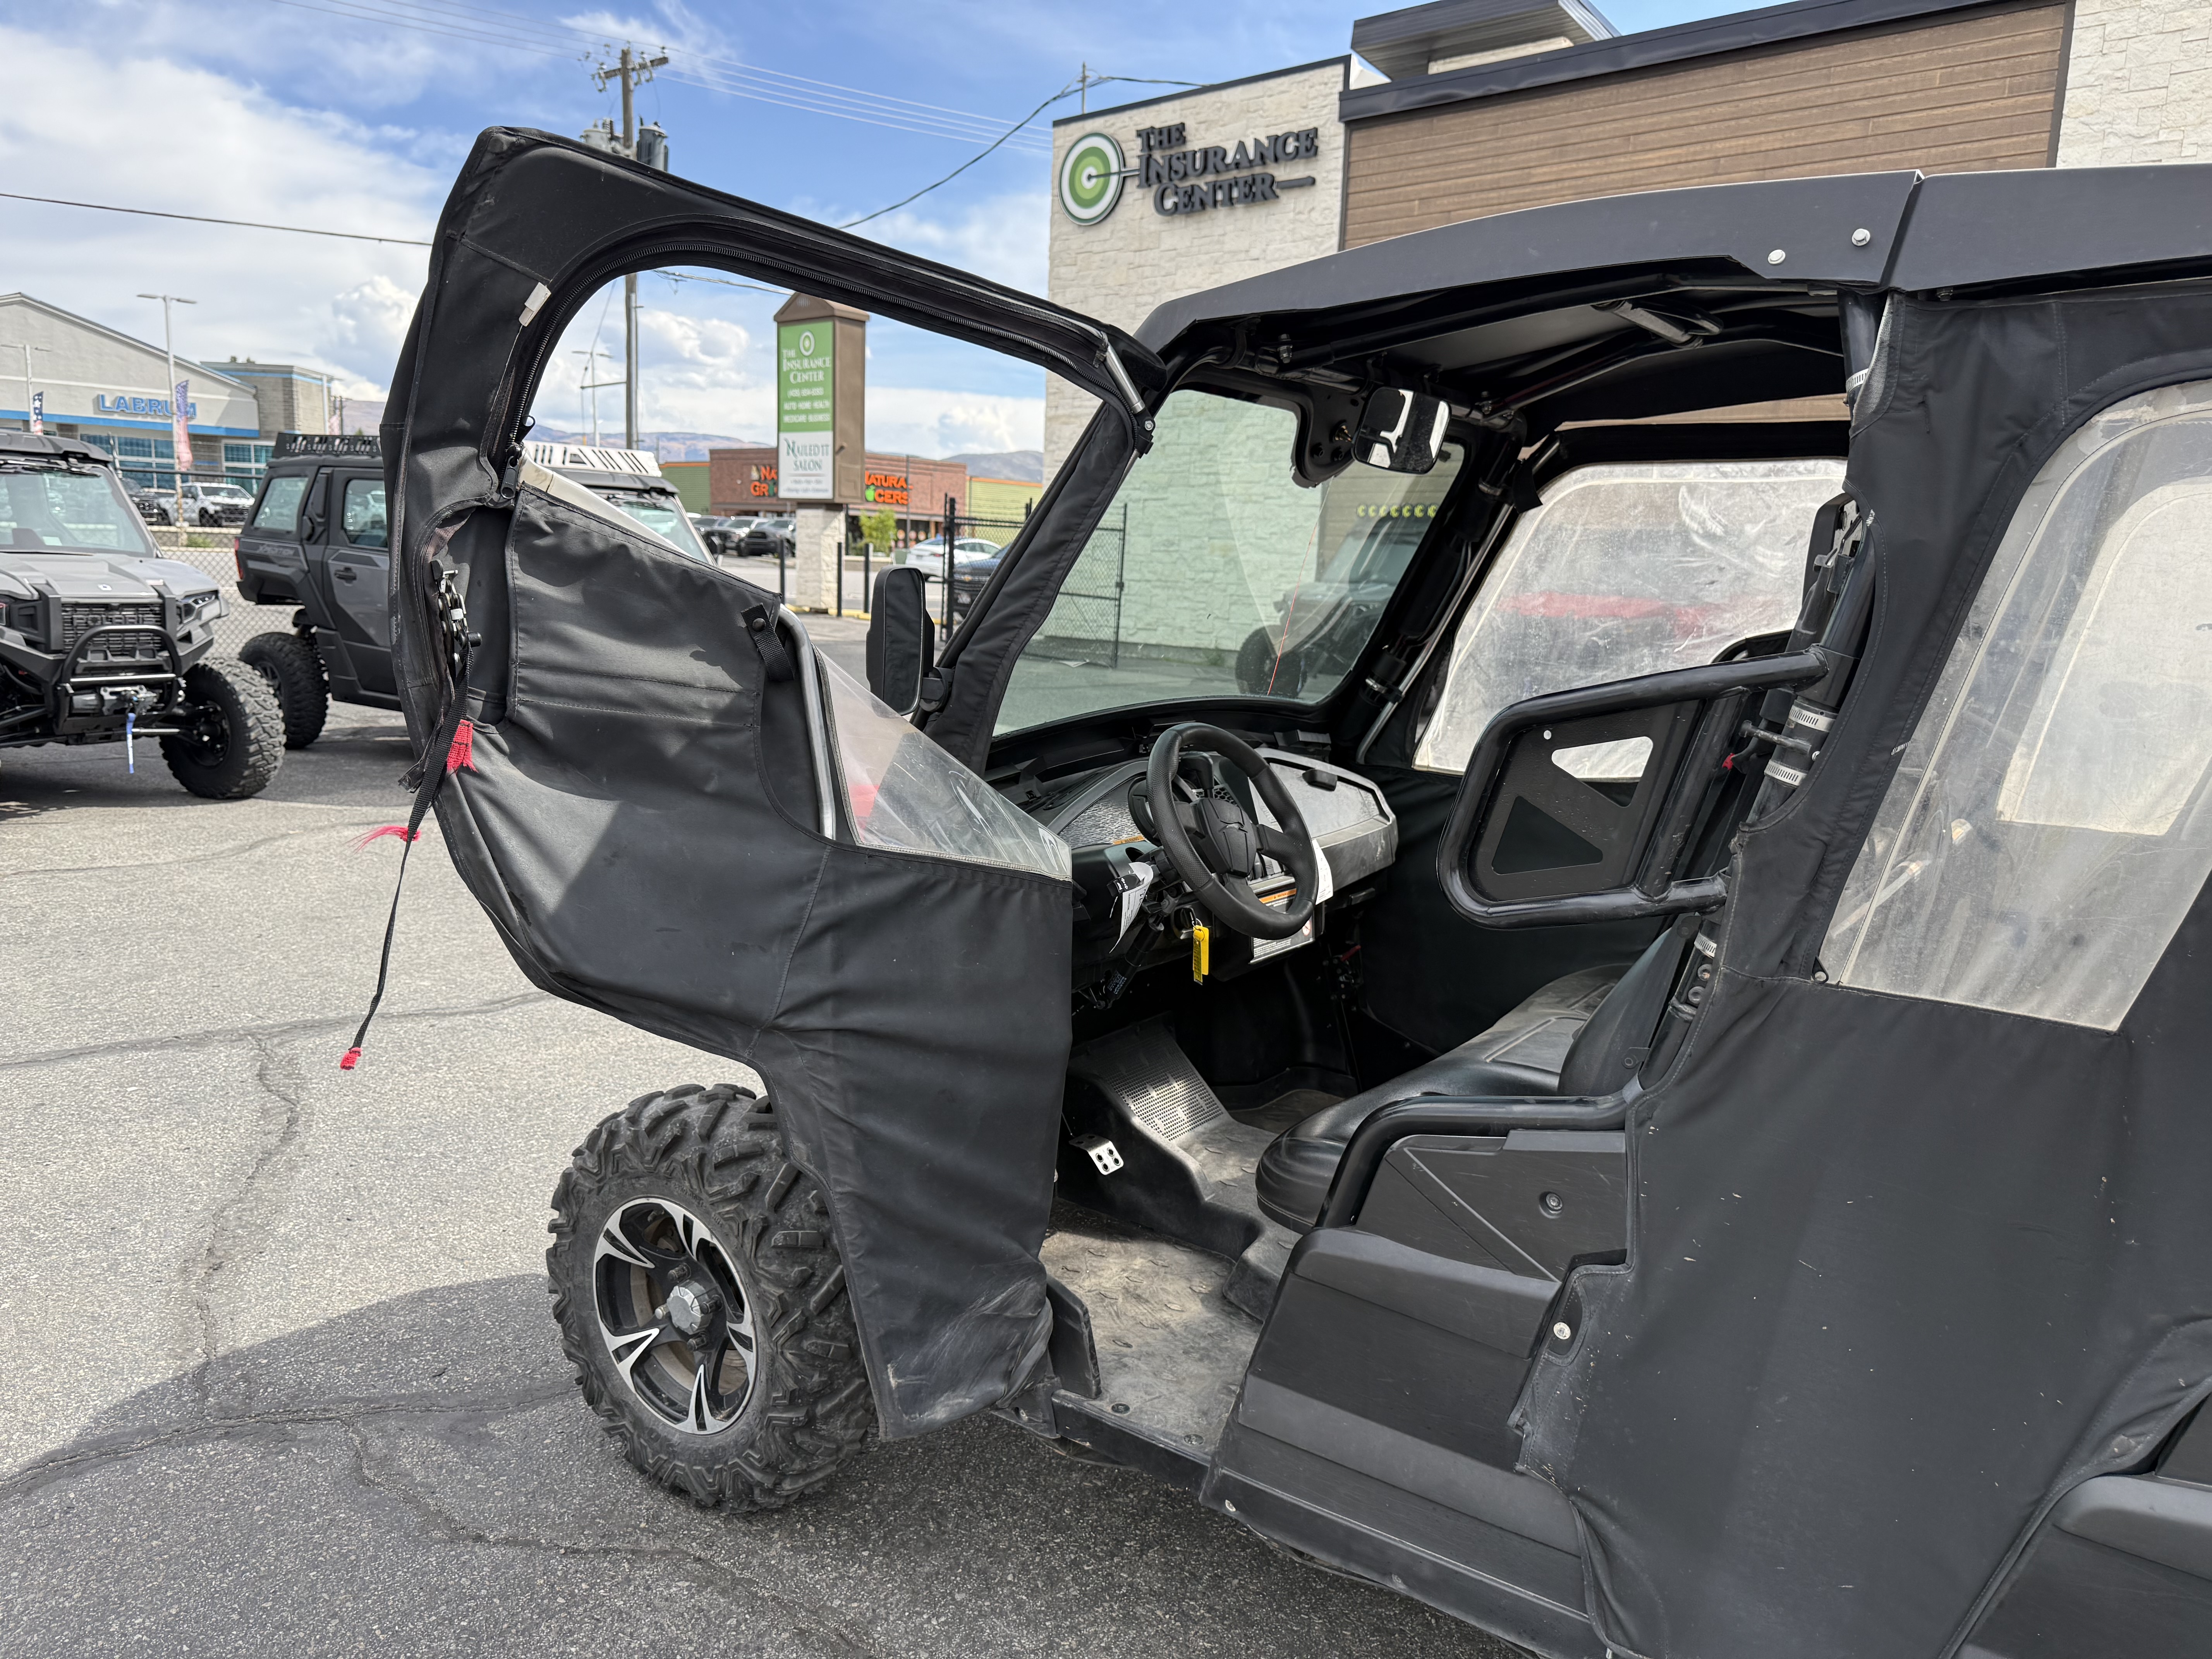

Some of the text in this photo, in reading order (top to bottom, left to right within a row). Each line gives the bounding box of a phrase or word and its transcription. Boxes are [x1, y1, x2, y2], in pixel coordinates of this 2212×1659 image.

[1137, 122, 1185, 153] THE
[1137, 127, 1318, 188] INSURANCE
[1154, 173, 1279, 216] CENTER
[790, 370, 824, 384] CENTER
[72, 615, 156, 625] POLARIS
